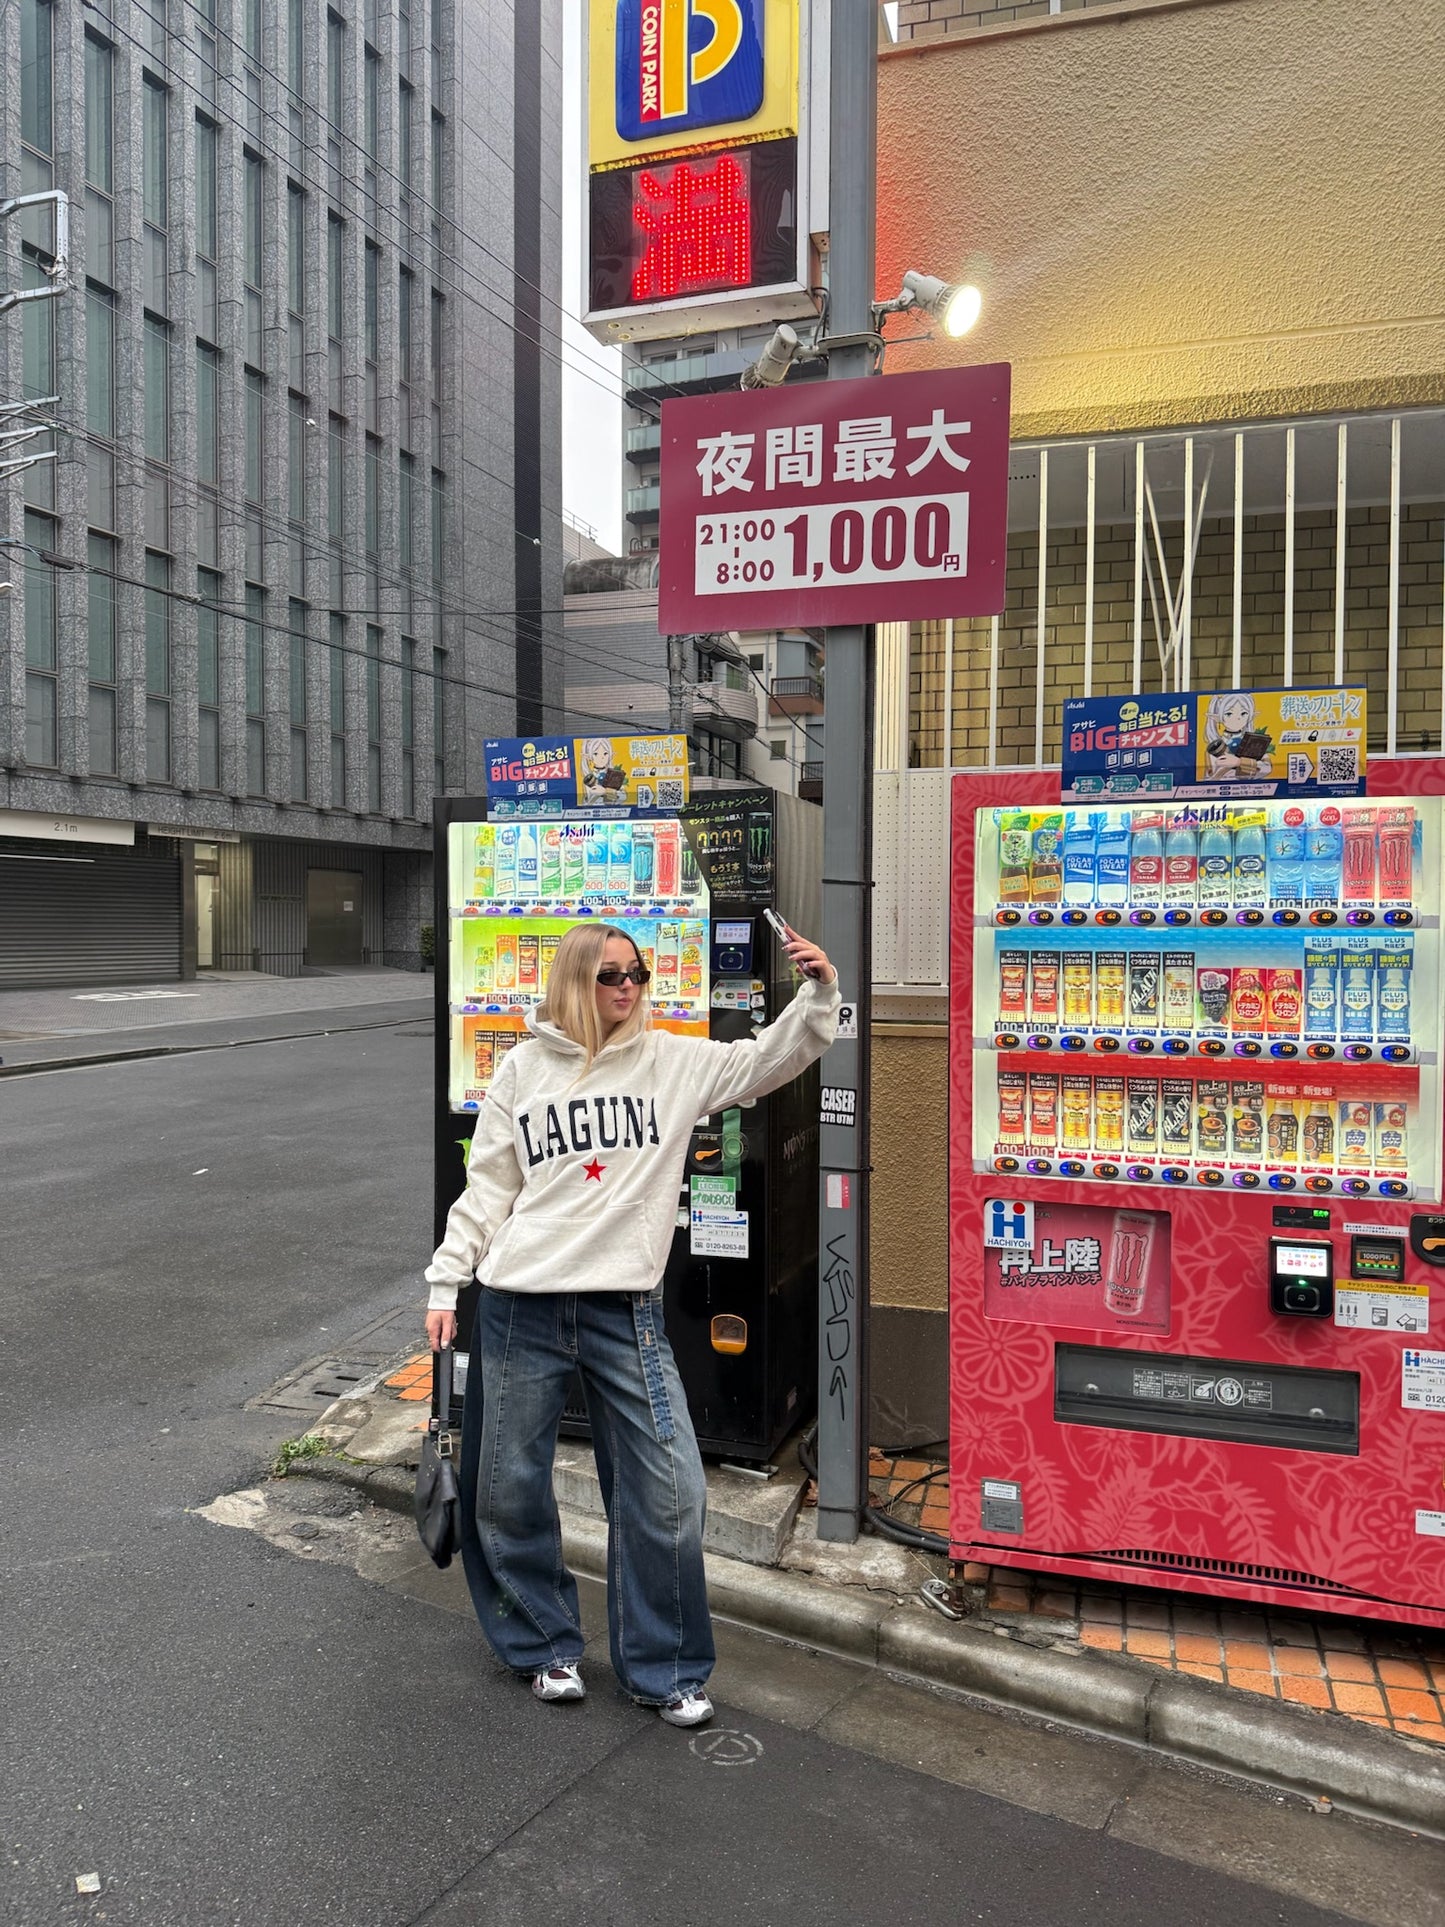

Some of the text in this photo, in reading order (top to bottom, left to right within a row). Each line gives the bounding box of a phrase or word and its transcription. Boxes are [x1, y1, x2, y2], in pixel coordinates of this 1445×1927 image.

[642, 7, 658, 115] COIN PARK
[696, 409, 971, 497] 夜間最大
[700, 519, 776, 545] 21:00
[716, 560, 775, 584] 8:00
[1072, 720, 1096, 732] アサヒ
[1121, 725, 1186, 747] チャンス!
[1070, 726, 1117, 752] BIG
[491, 761, 523, 782] BIG
[1174, 804, 1227, 823] Asahi
[560, 823, 595, 838] Asahi
[1130, 969, 1157, 1009] BLACK
[821, 1088, 855, 1113] CASER
[836, 1114, 854, 1125] UTM
[1129, 1095, 1156, 1135] BLACK
[1163, 1096, 1191, 1136] BLACK
[519, 1096, 660, 1168] LAGUNA
[987, 1238, 1031, 1248] HACHIYOH
